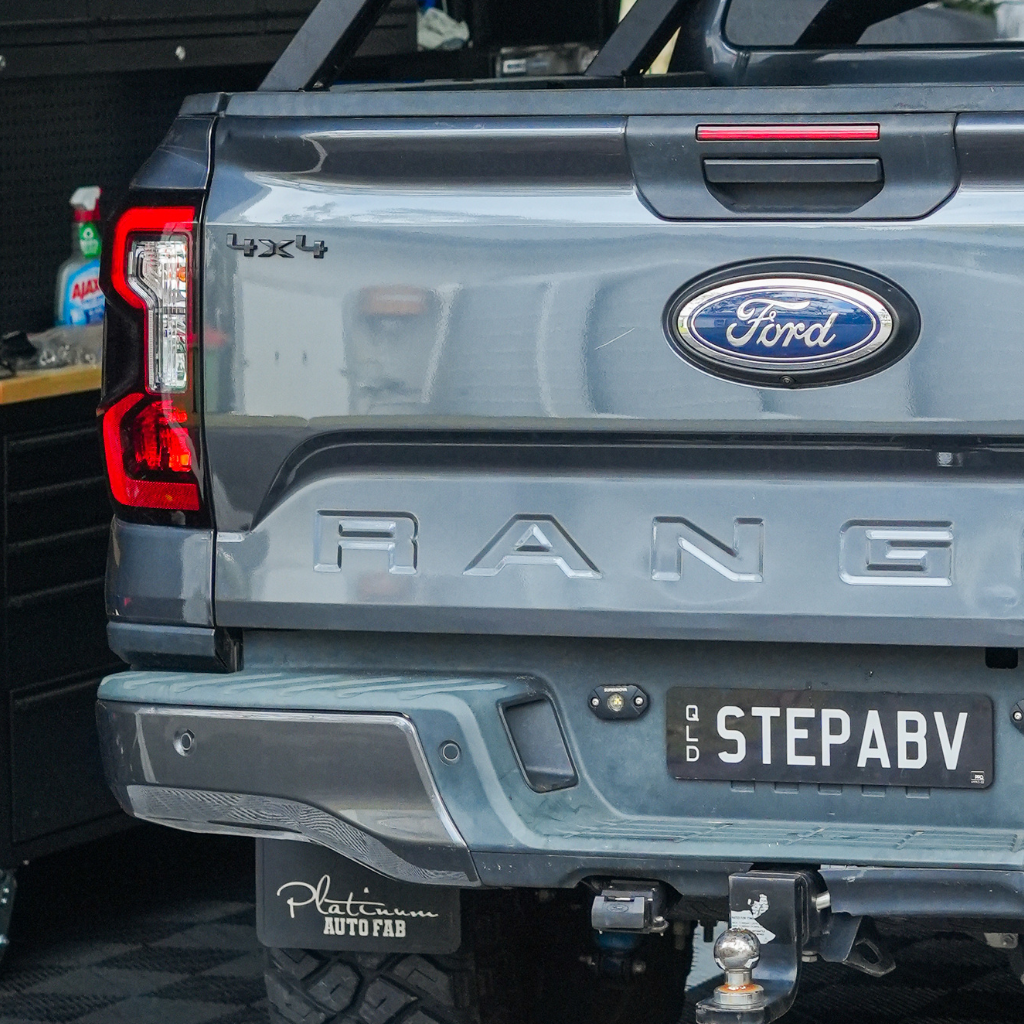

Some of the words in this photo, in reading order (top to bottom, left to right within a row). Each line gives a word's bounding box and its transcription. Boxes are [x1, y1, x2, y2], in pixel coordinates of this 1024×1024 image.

[71, 278, 99, 300] AJAX
[726, 298, 838, 347] Ford
[717, 705, 968, 770] STEPABV
[277, 874, 439, 918] Platinum
[323, 917, 369, 937] AUTO
[373, 919, 406, 937] FAB
